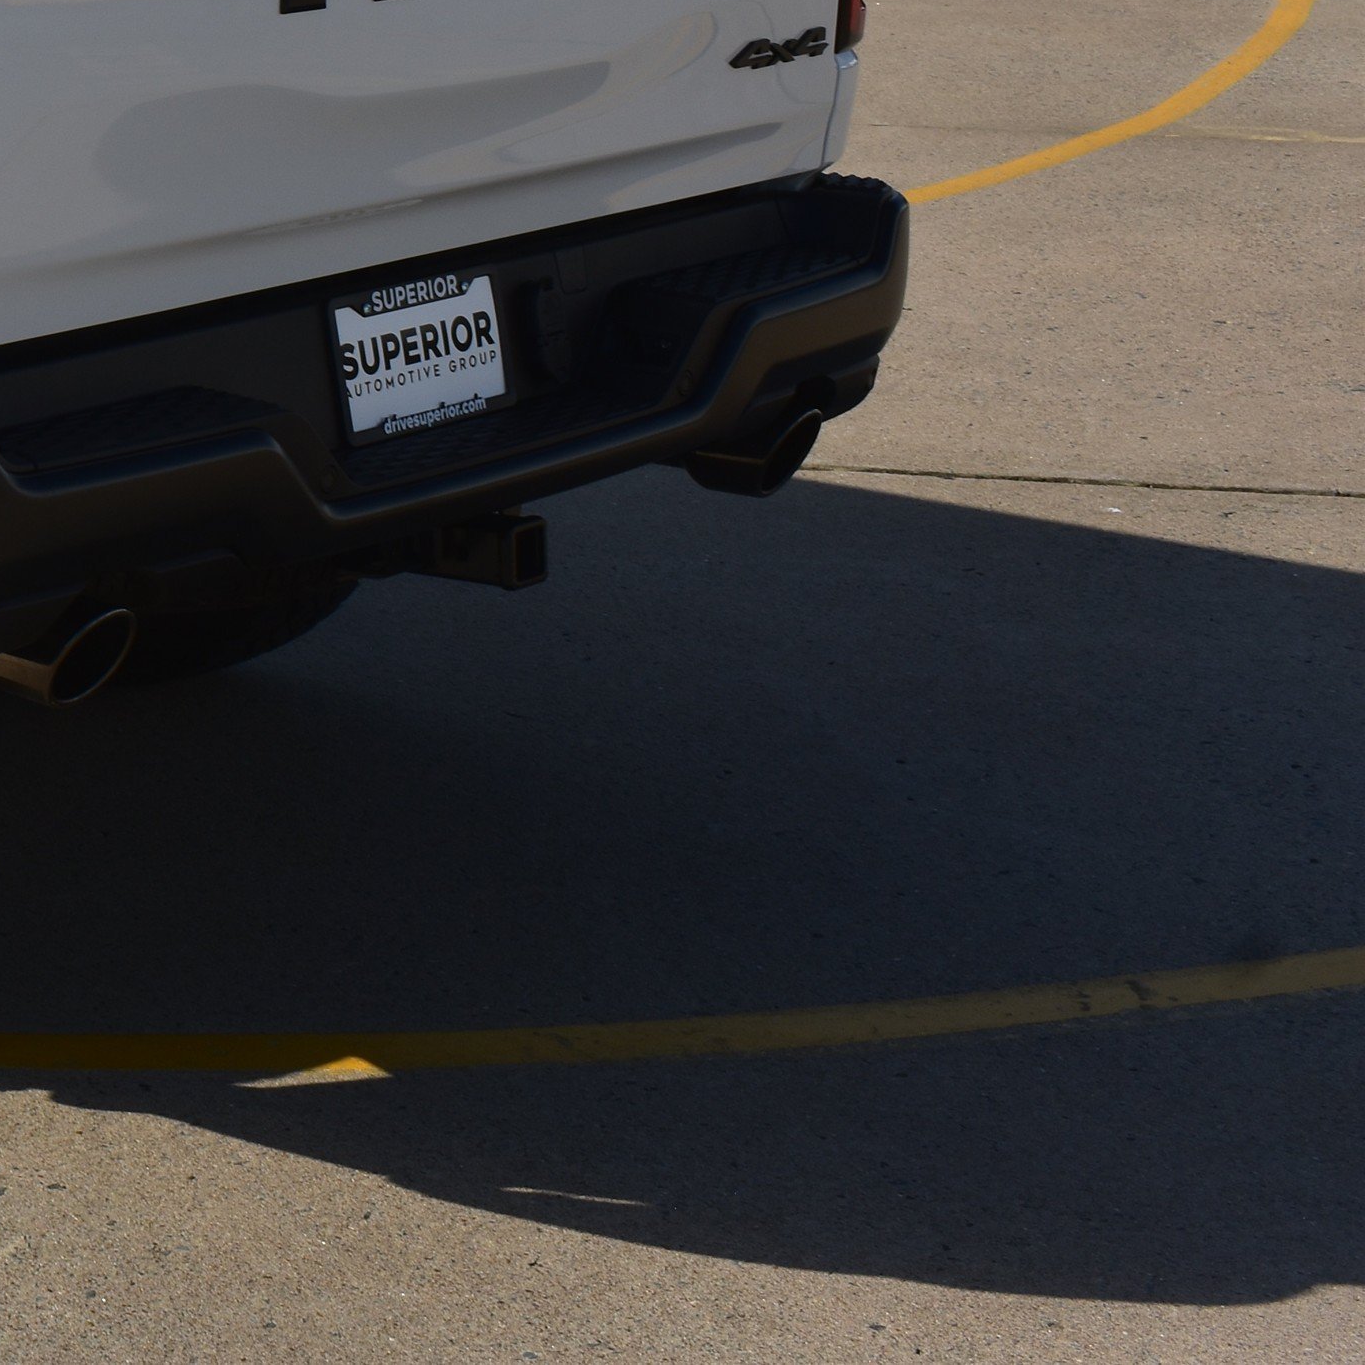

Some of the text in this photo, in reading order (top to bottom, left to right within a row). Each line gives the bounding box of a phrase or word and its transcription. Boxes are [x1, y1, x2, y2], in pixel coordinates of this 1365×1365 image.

[729, 26, 828, 69] 4x4
[371, 274, 459, 313] SUPERIOR
[340, 310, 495, 381] SUPERIOR
[449, 349, 497, 373] GROUP
[383, 395, 487, 435] drivesuperior.com
